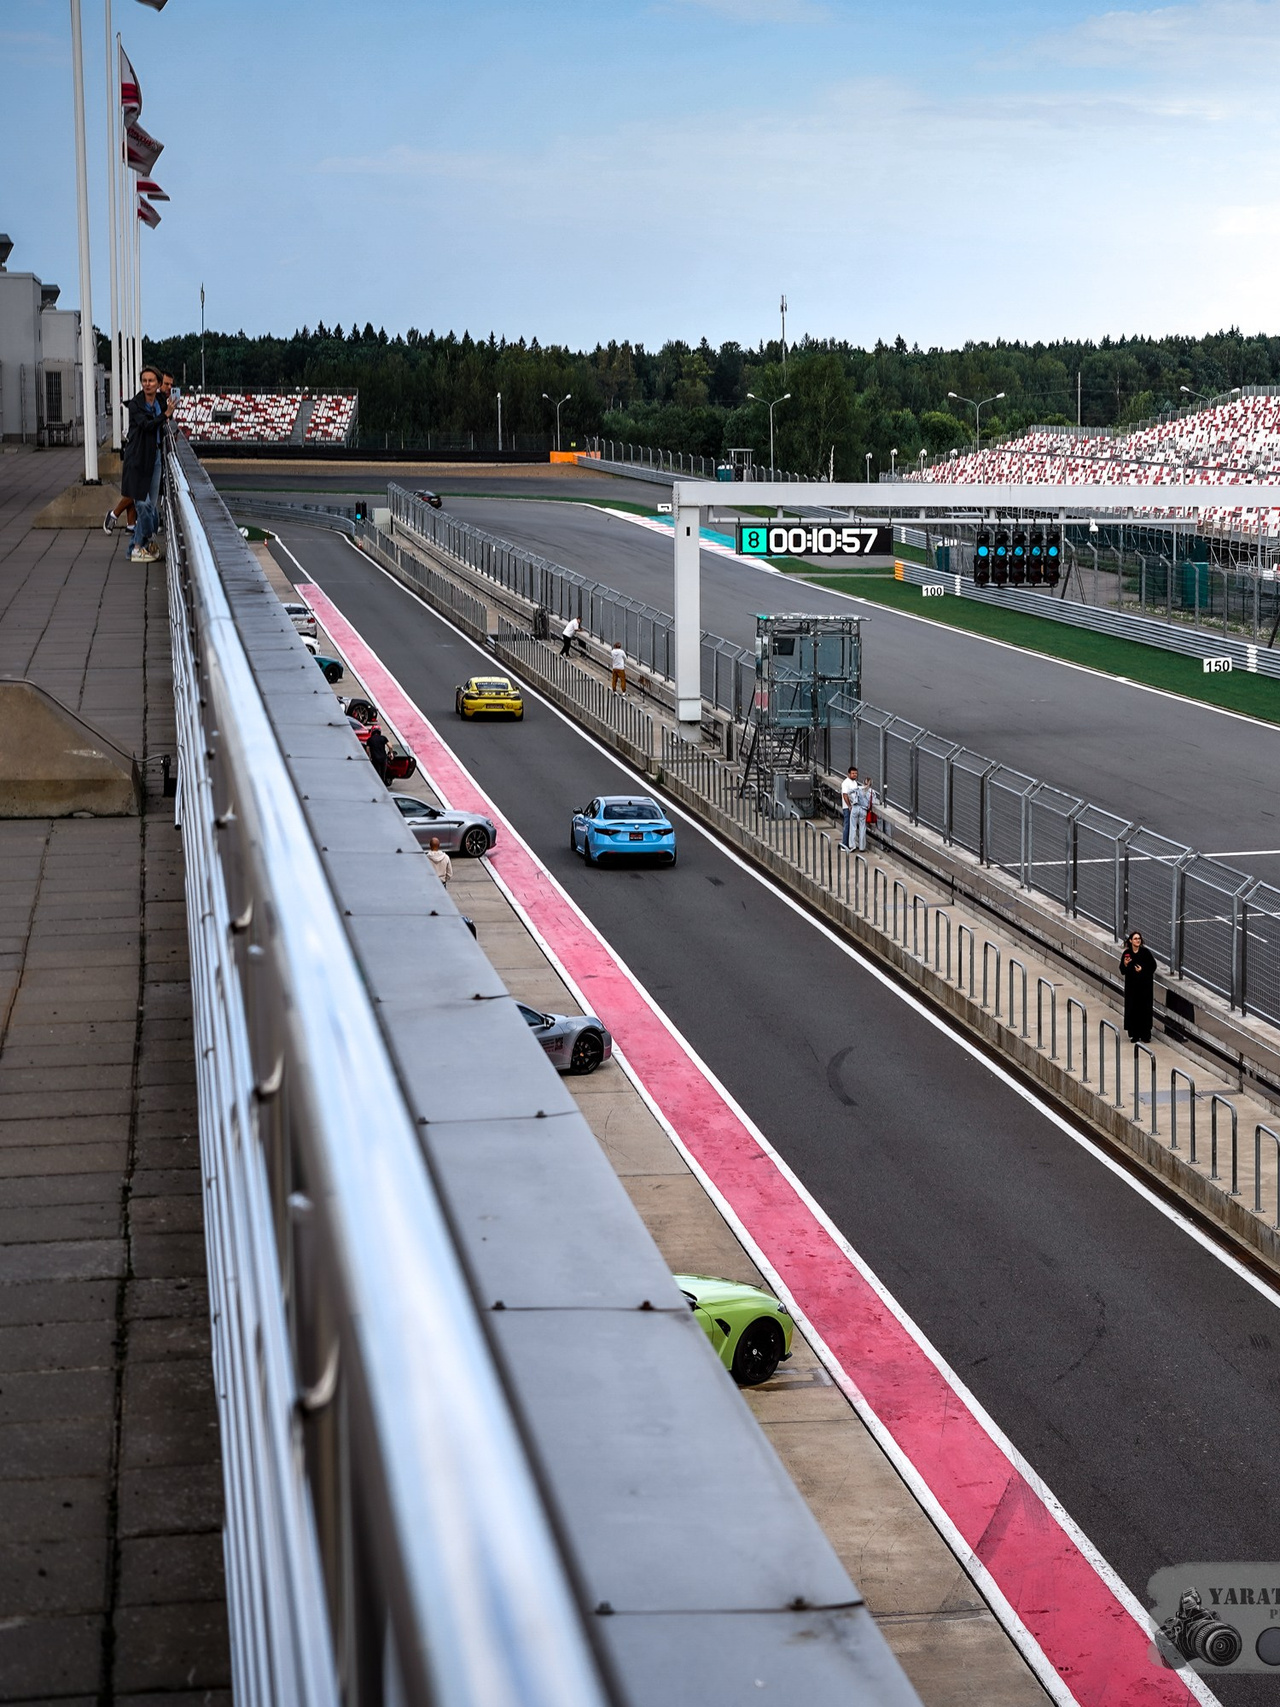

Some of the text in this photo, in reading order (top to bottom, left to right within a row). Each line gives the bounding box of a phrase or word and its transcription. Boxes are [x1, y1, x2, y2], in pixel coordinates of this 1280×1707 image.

[748, 528, 878, 553] 8 00:10:57
[924, 587, 943, 596] 100
[1206, 660, 1230, 672] 150
